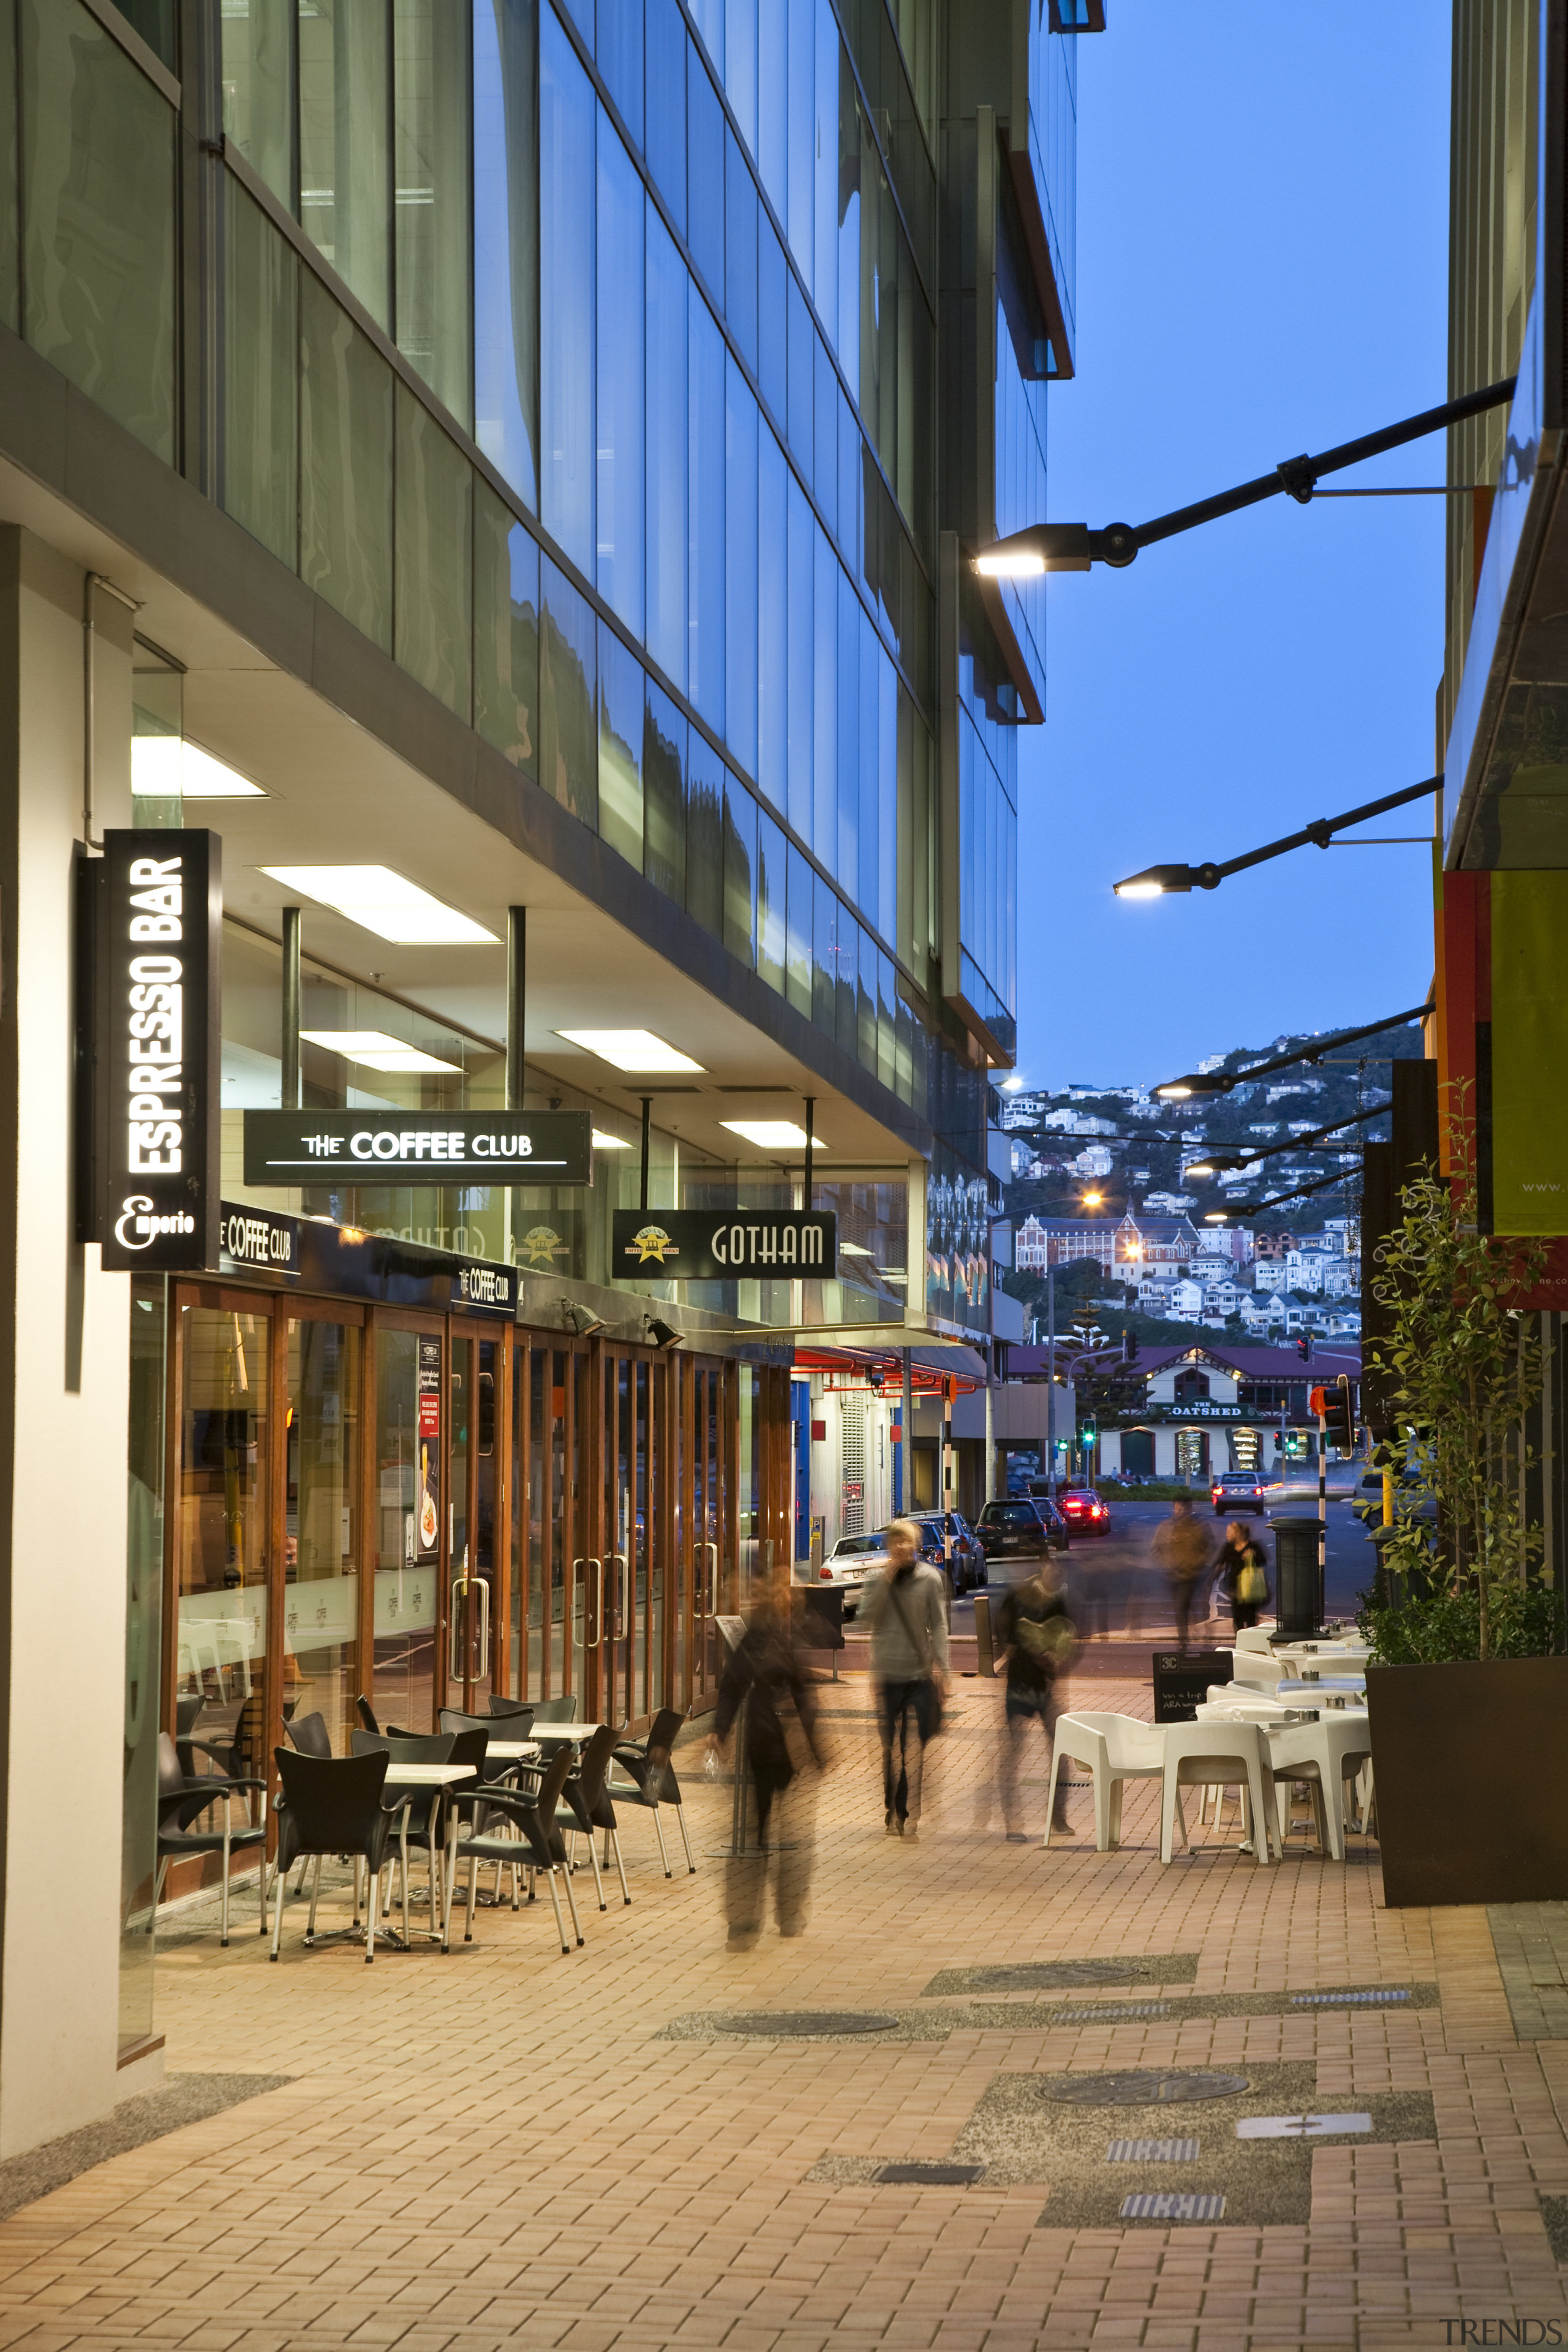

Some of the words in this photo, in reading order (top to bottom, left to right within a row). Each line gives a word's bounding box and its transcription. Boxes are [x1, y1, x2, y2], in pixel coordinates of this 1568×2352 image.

[129, 856, 183, 941] BAR
[129, 956, 183, 1173] ESPRESSO
[301, 1134, 345, 1156] THE
[350, 1131, 465, 1159] COFFEE
[472, 1134, 532, 1156] CLUB
[228, 1215, 268, 1261] COFFEE
[270, 1228, 290, 1261] CLUB
[638, 1226, 667, 1238] HAVANA
[711, 1225, 823, 1265] GOTHAM
[459, 1268, 469, 1295] THE
[470, 1267, 495, 1303] COFFEE
[496, 1275, 508, 1302] CLUB
